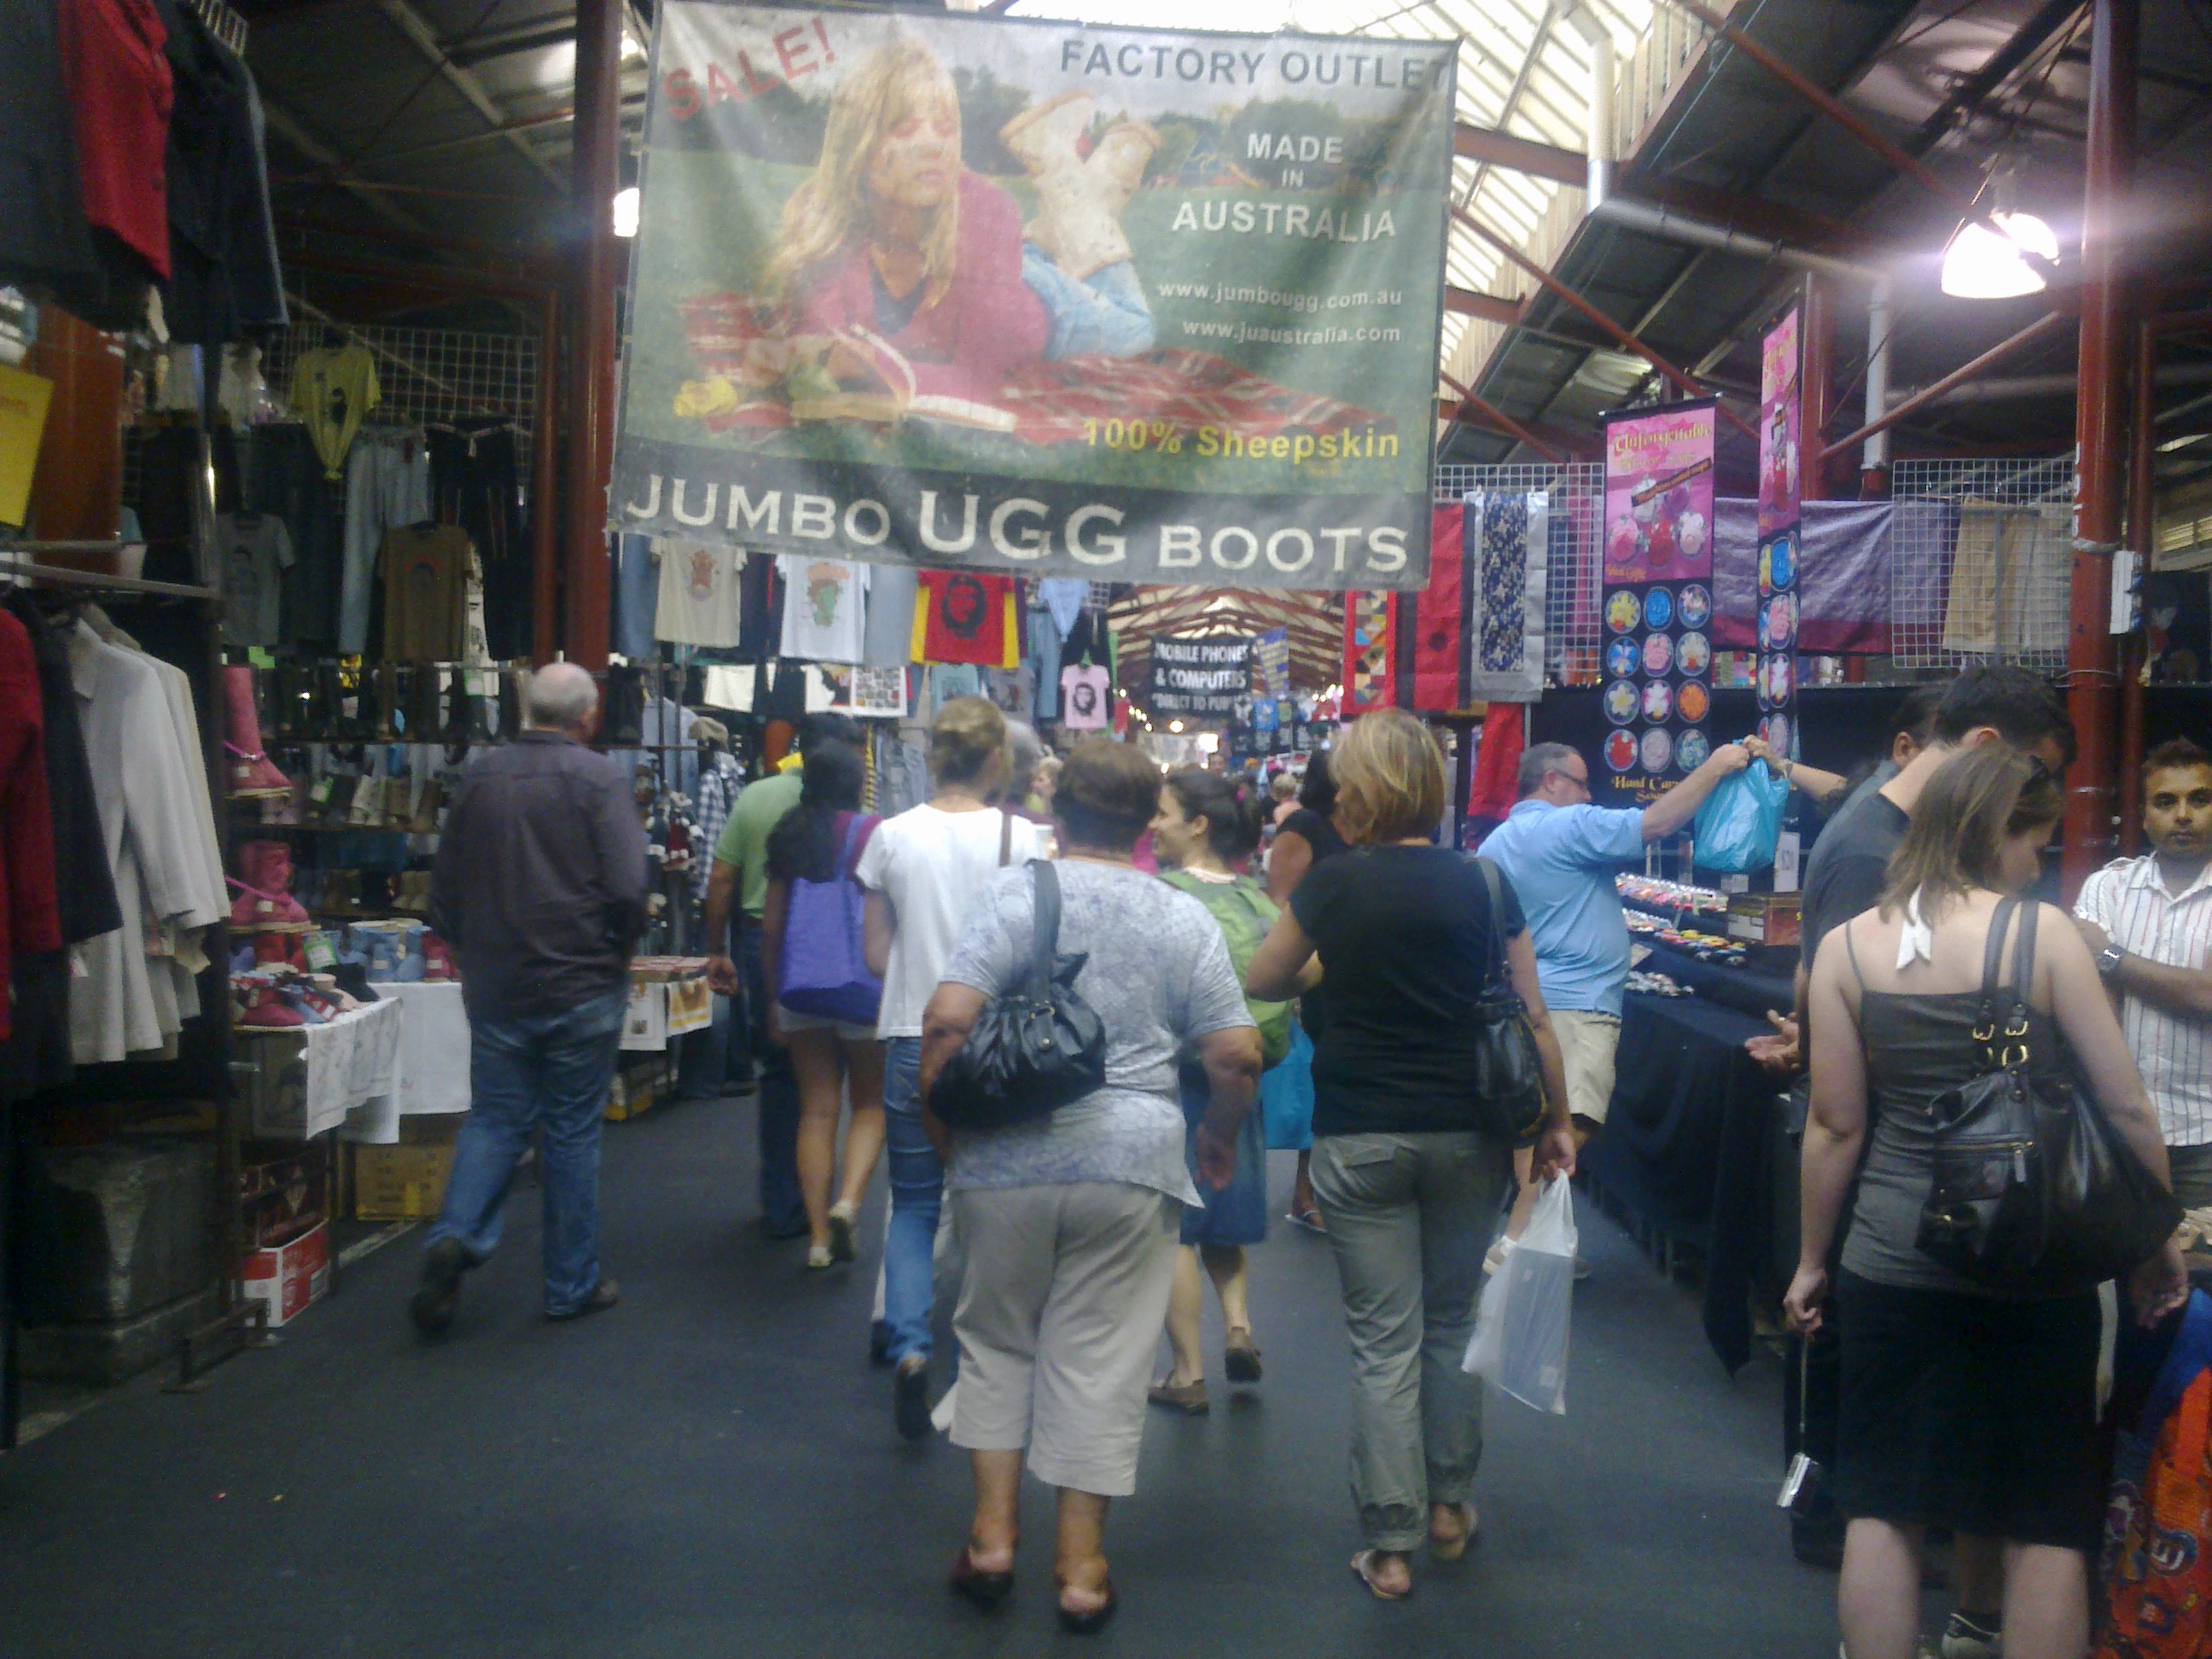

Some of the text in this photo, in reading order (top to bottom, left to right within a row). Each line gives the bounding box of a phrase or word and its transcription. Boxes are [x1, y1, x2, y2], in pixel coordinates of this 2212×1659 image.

[664, 16, 837, 121] SALE!
[1061, 39, 1266, 84] FACTORY
[1246, 132, 1344, 163] MADE
[1281, 169, 1304, 188] IN
[1171, 200, 1397, 244] AUSTRALIA
[1157, 282, 1402, 314] www.jumbougg.com.au
[1183, 319, 1402, 345] www.juaustralia.com
[1083, 416, 1400, 464] 100% Sheepskin
[626, 474, 1408, 573] JUMBO UGG BOOTS
[1153, 642, 1249, 664] MOBILE PHONES
[1155, 667, 1247, 690] & COMPUTERS
